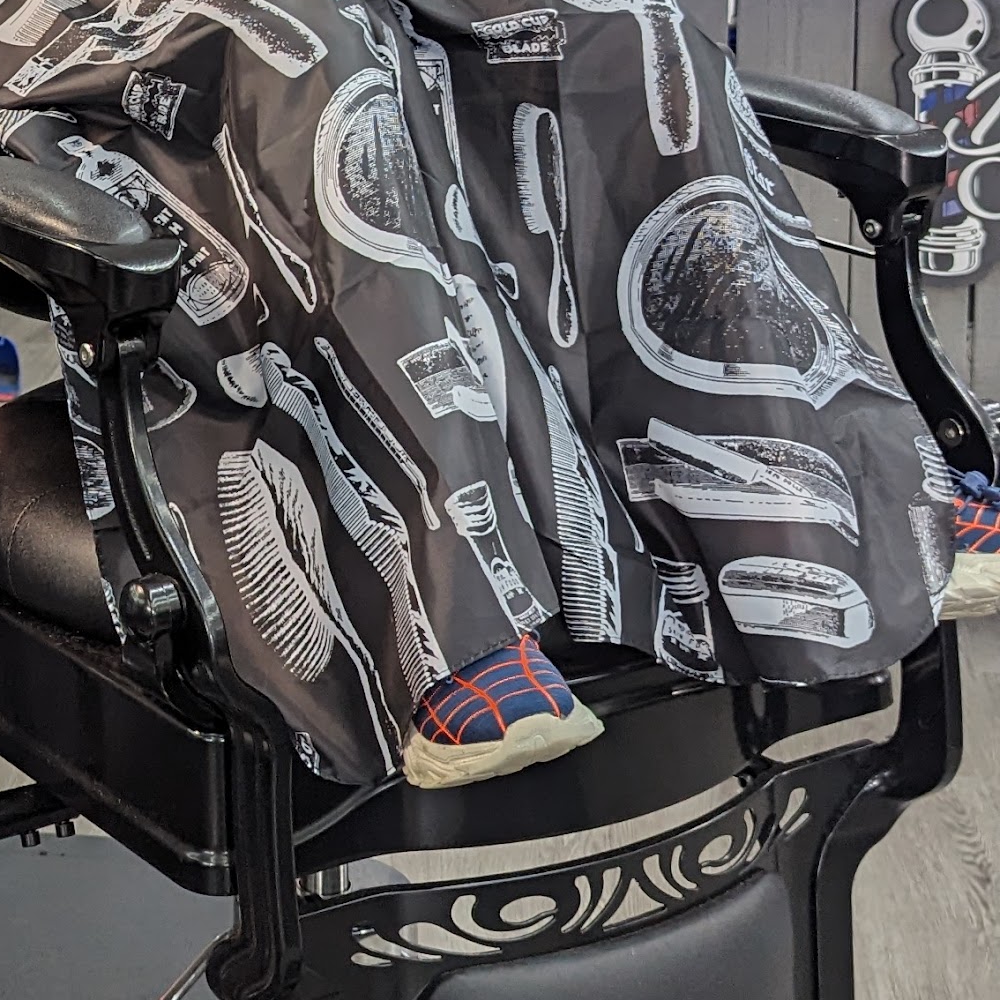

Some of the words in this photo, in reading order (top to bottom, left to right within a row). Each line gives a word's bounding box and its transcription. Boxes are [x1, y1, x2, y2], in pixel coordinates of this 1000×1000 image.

[482, 20, 520, 36] GOLD
[521, 15, 550, 28] CUP
[501, 41, 552, 55] BLADE
